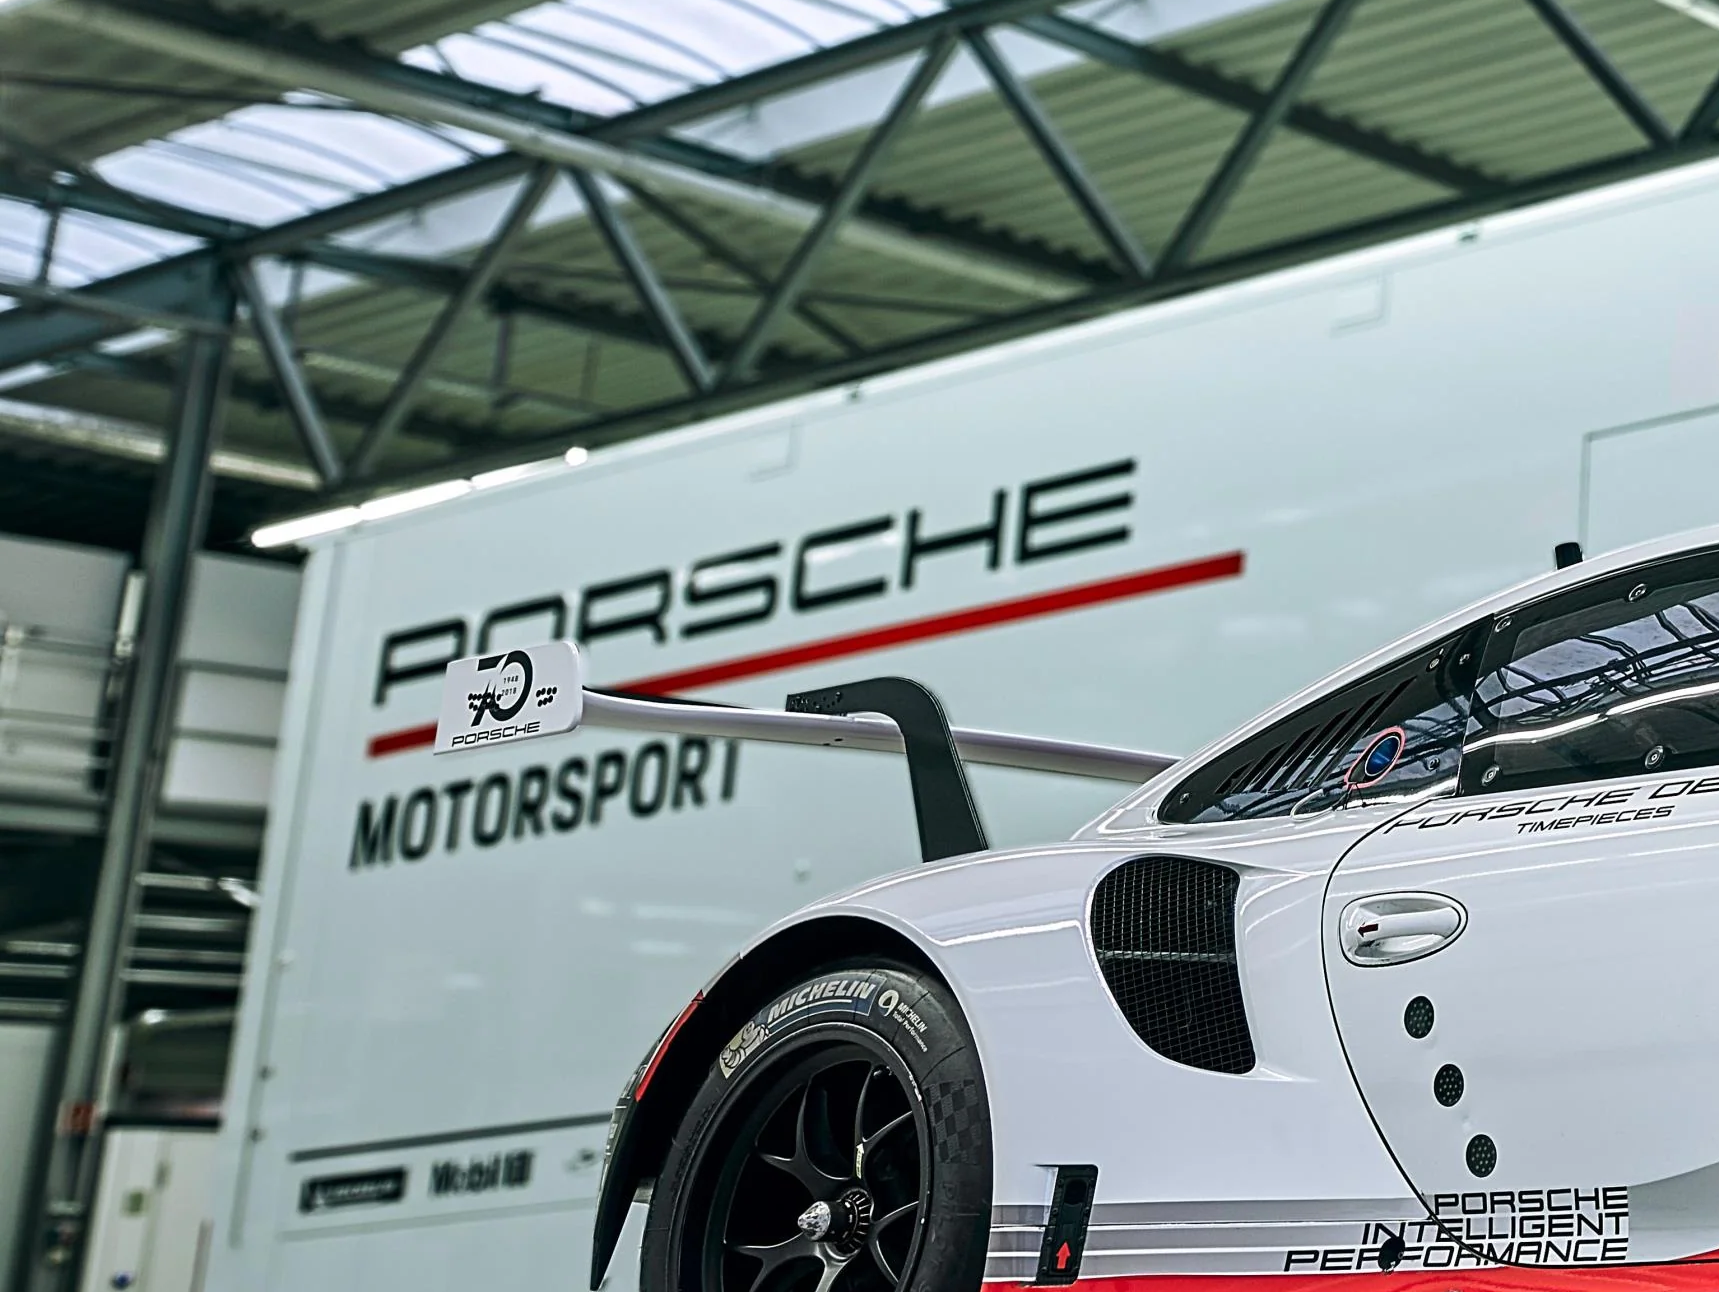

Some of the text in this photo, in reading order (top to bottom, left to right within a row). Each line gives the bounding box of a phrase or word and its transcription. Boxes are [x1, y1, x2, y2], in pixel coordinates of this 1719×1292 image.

[375, 458, 1137, 706] PORSCHE
[501, 687, 517, 696] 2018
[503, 675, 519, 684] 1948
[451, 721, 541, 747] PORSCHE
[1517, 805, 1676, 834] TIMEPIECES
[766, 979, 876, 1025] MICHELIN
[898, 1002, 928, 1033] MICHELIN
[1434, 1186, 1629, 1216] PORSCHE
[1361, 1211, 1630, 1245] INTELLIGENT
